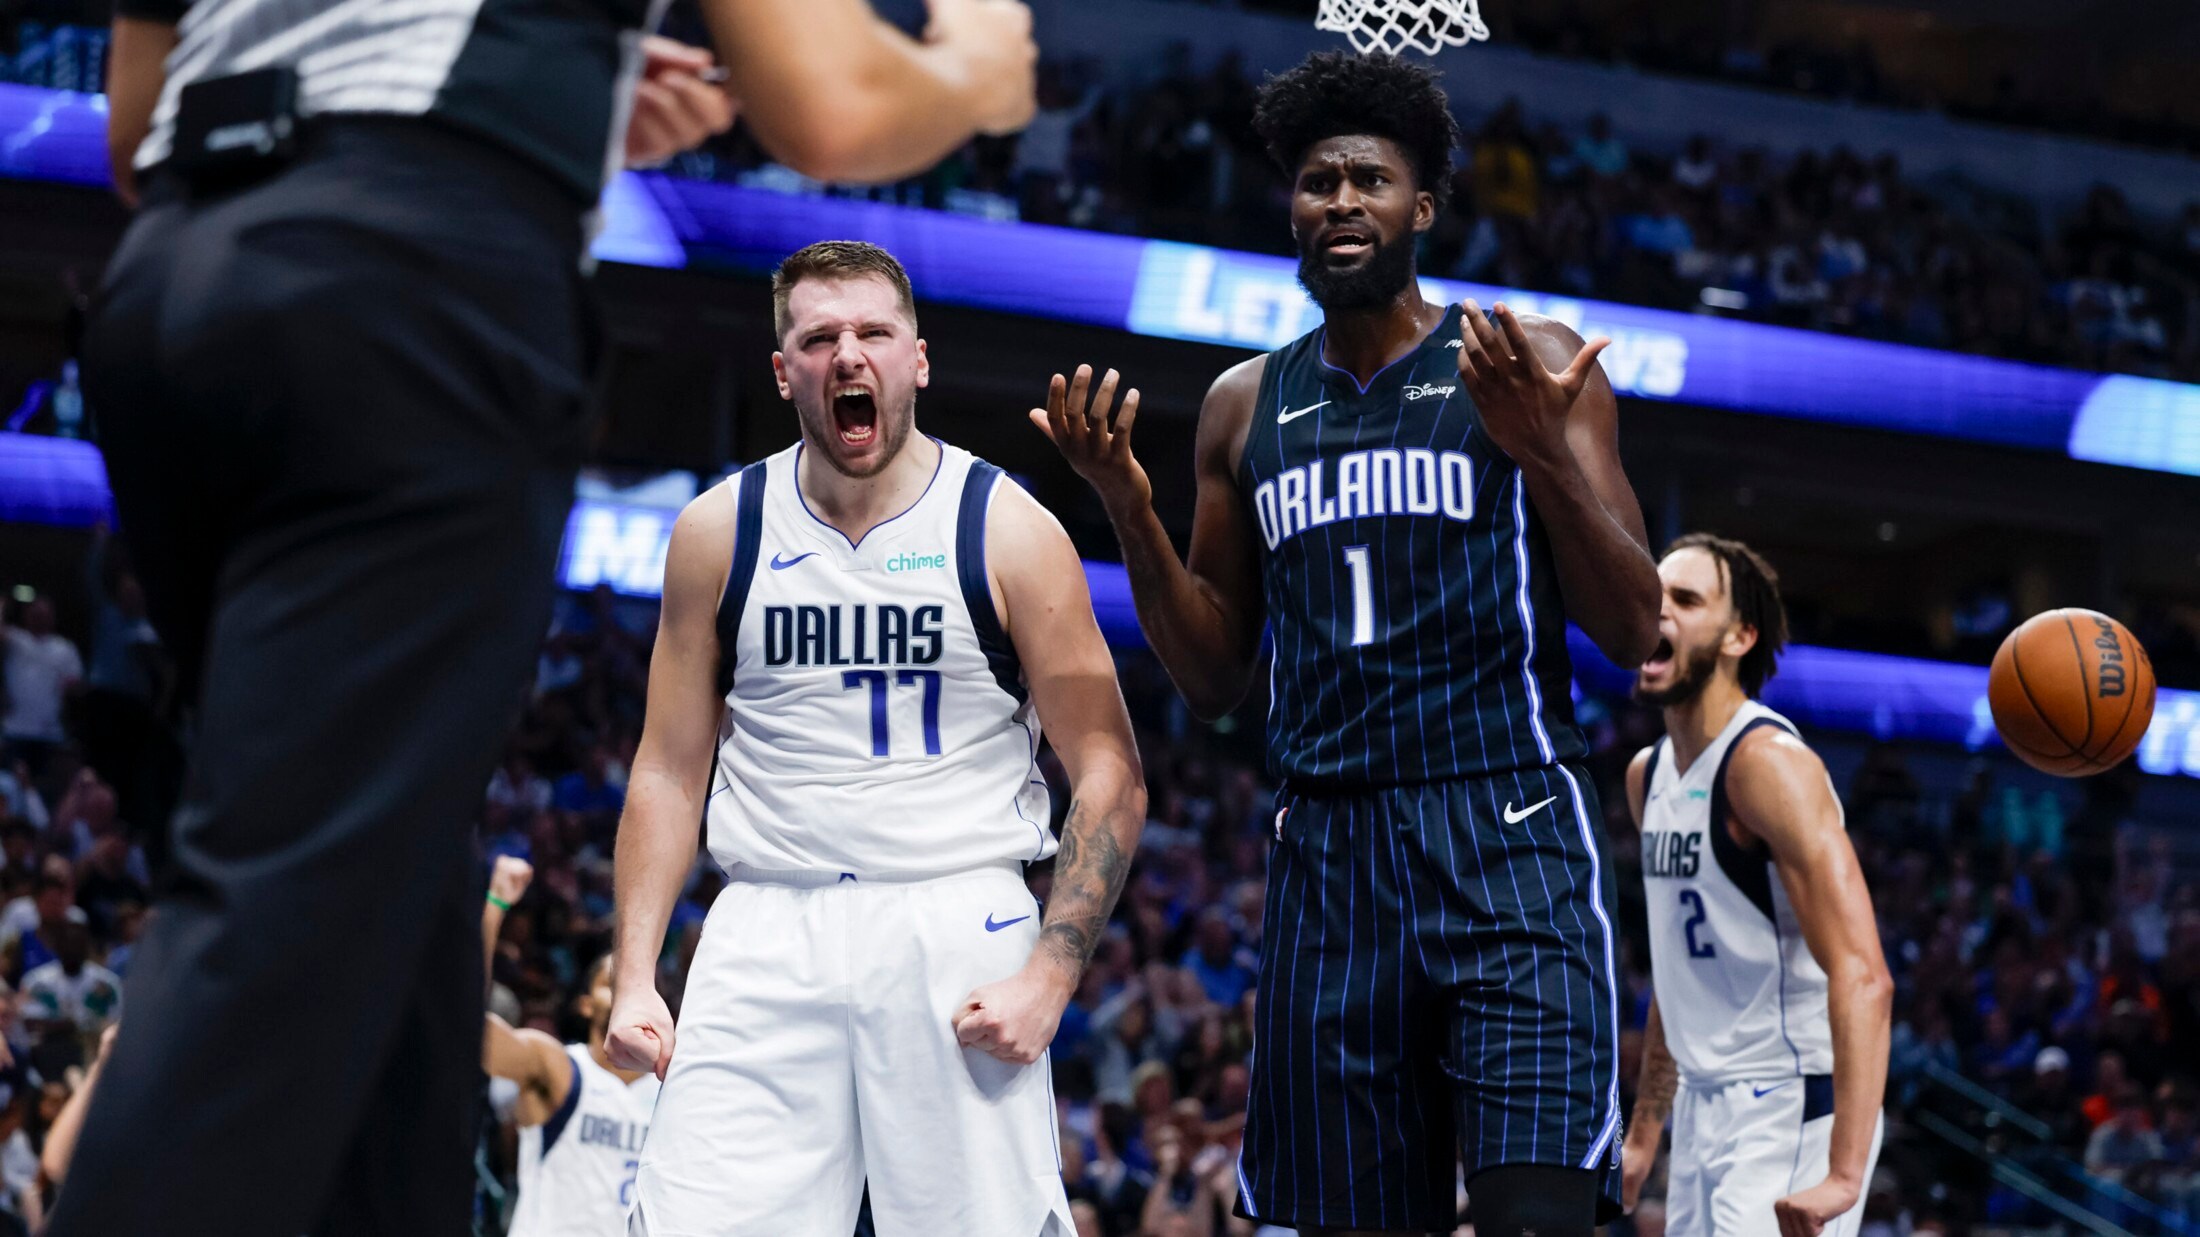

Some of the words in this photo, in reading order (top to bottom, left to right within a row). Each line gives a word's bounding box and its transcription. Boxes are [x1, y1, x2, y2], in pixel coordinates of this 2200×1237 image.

[1176, 249, 1309, 347] LET
[1403, 383, 1457, 400] Disney
[1255, 447, 1476, 551] ORLANDO
[886, 552, 946, 573] chime
[1342, 544, 1376, 646] 1
[763, 603, 945, 668] DALLAS
[841, 669, 943, 758] 77
[1680, 889, 1716, 958] 2
